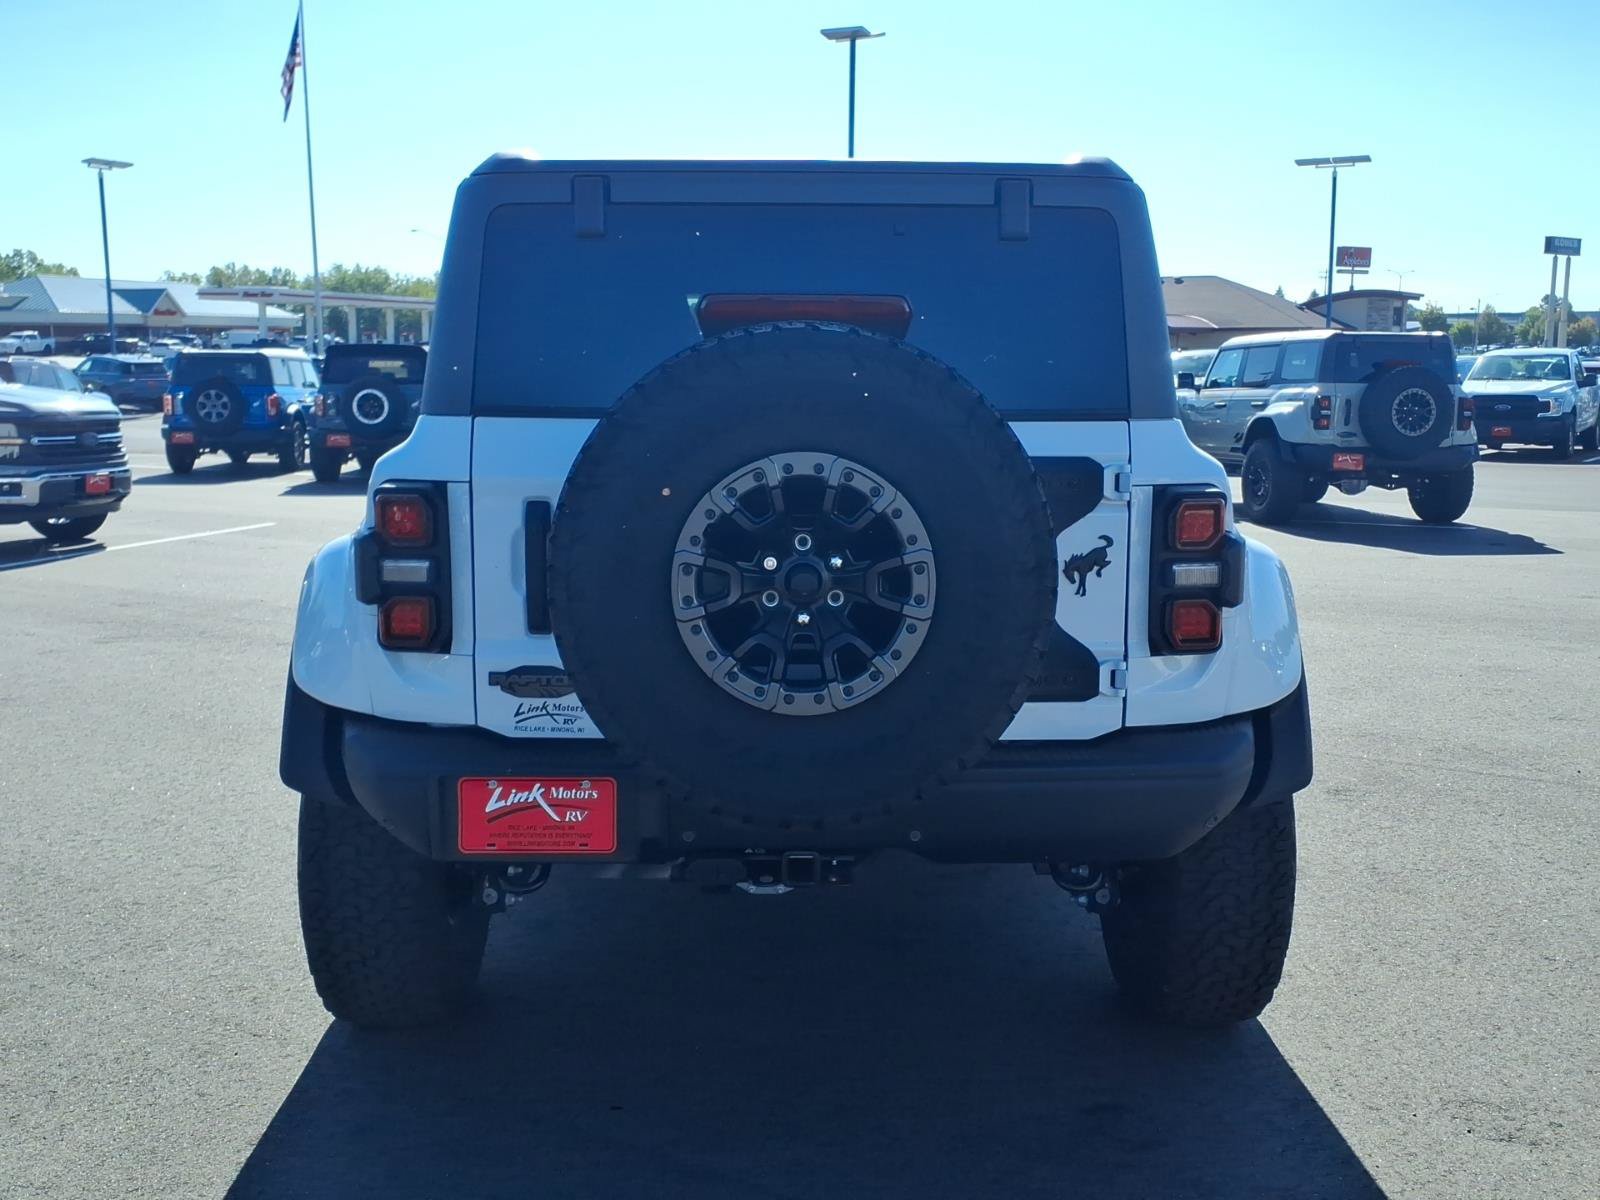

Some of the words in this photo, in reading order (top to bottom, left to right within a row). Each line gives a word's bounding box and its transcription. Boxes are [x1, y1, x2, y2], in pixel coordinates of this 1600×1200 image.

[513, 701, 559, 724] Link
[552, 703, 585, 713] Motors
[485, 782, 561, 821] Link
[549, 786, 599, 799] Motors
[565, 810, 588, 822] RV
